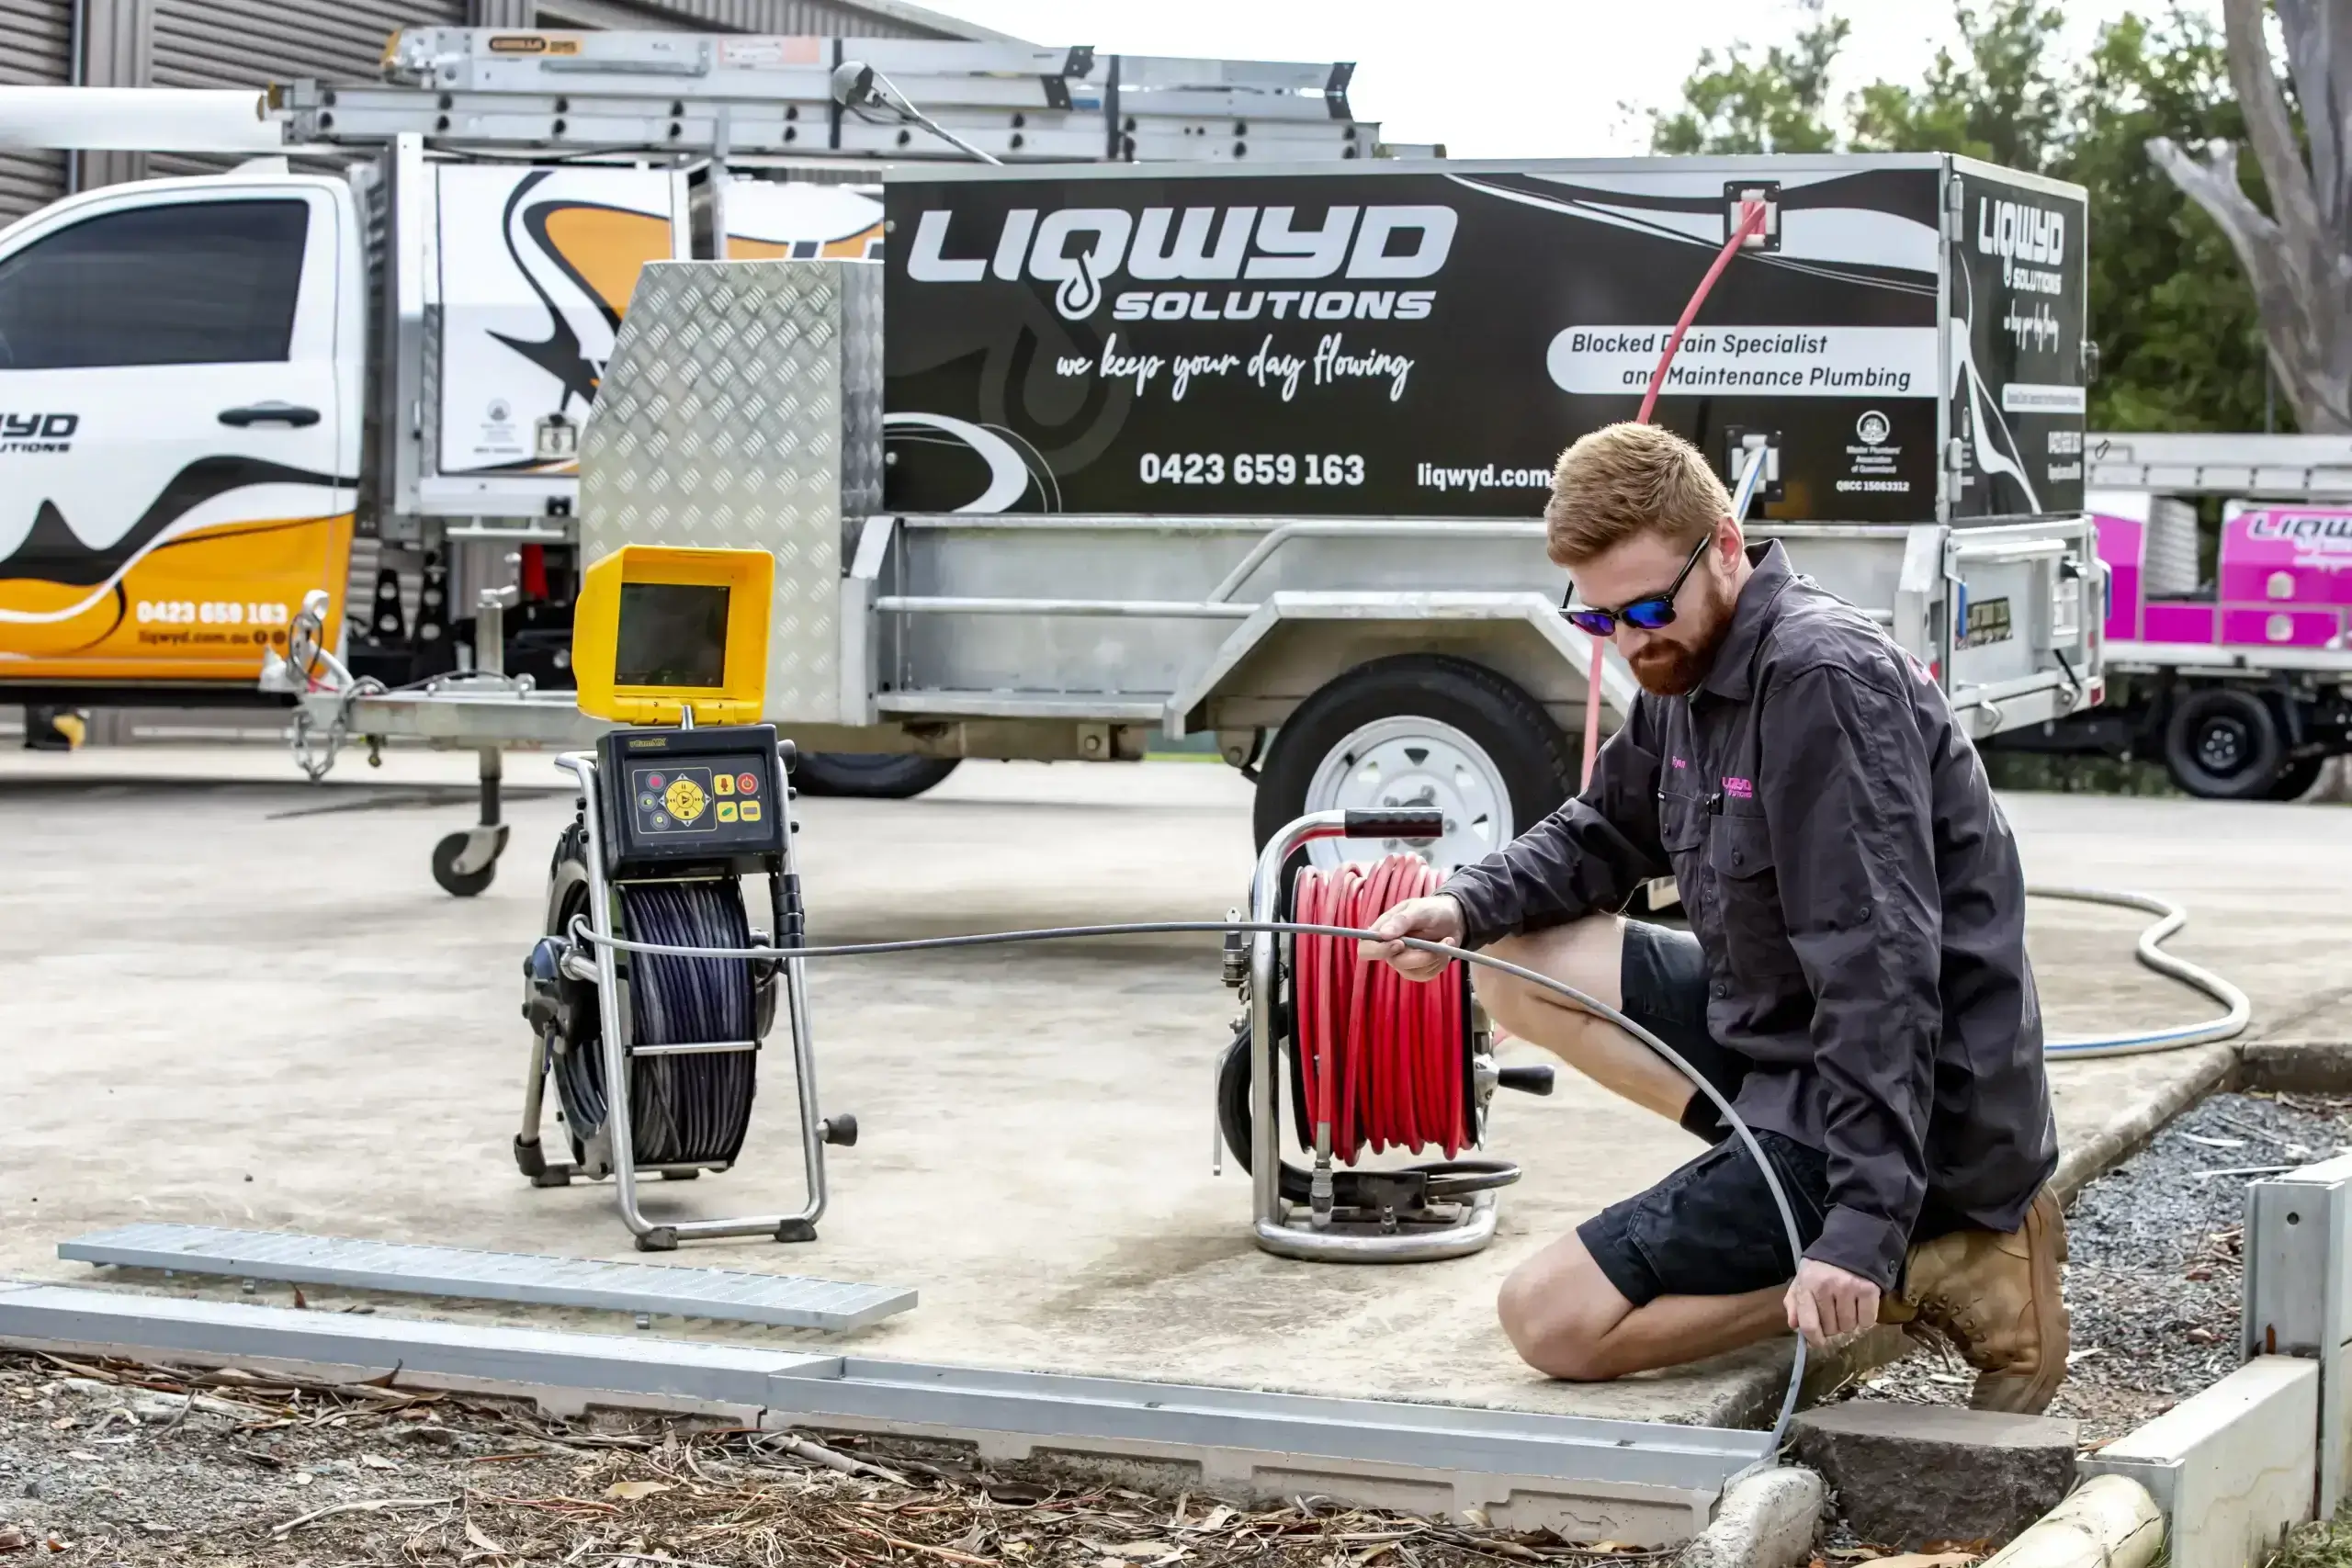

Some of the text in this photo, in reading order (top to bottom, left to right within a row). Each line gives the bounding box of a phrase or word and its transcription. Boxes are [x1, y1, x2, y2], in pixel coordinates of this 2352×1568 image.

[1978, 196, 2065, 288] LIQWYD
[907, 205, 1459, 320] LIQWYD
[2012, 267, 2062, 295] SOLUTIONS
[1113, 290, 1437, 321] SOLUTIONS
[1572, 333, 1655, 353] Blocked
[1722, 333, 1827, 358] Specialist
[1057, 333, 1415, 402] we keep your day flowing
[1668, 367, 1803, 386] Maintenance
[1809, 367, 1911, 392] Plumbing
[1139, 453, 1226, 485] 0423
[1233, 454, 1296, 485] 659
[1304, 454, 1365, 486] 163
[136, 600, 195, 624] 0423
[1672, 755, 1686, 768] Ryan
